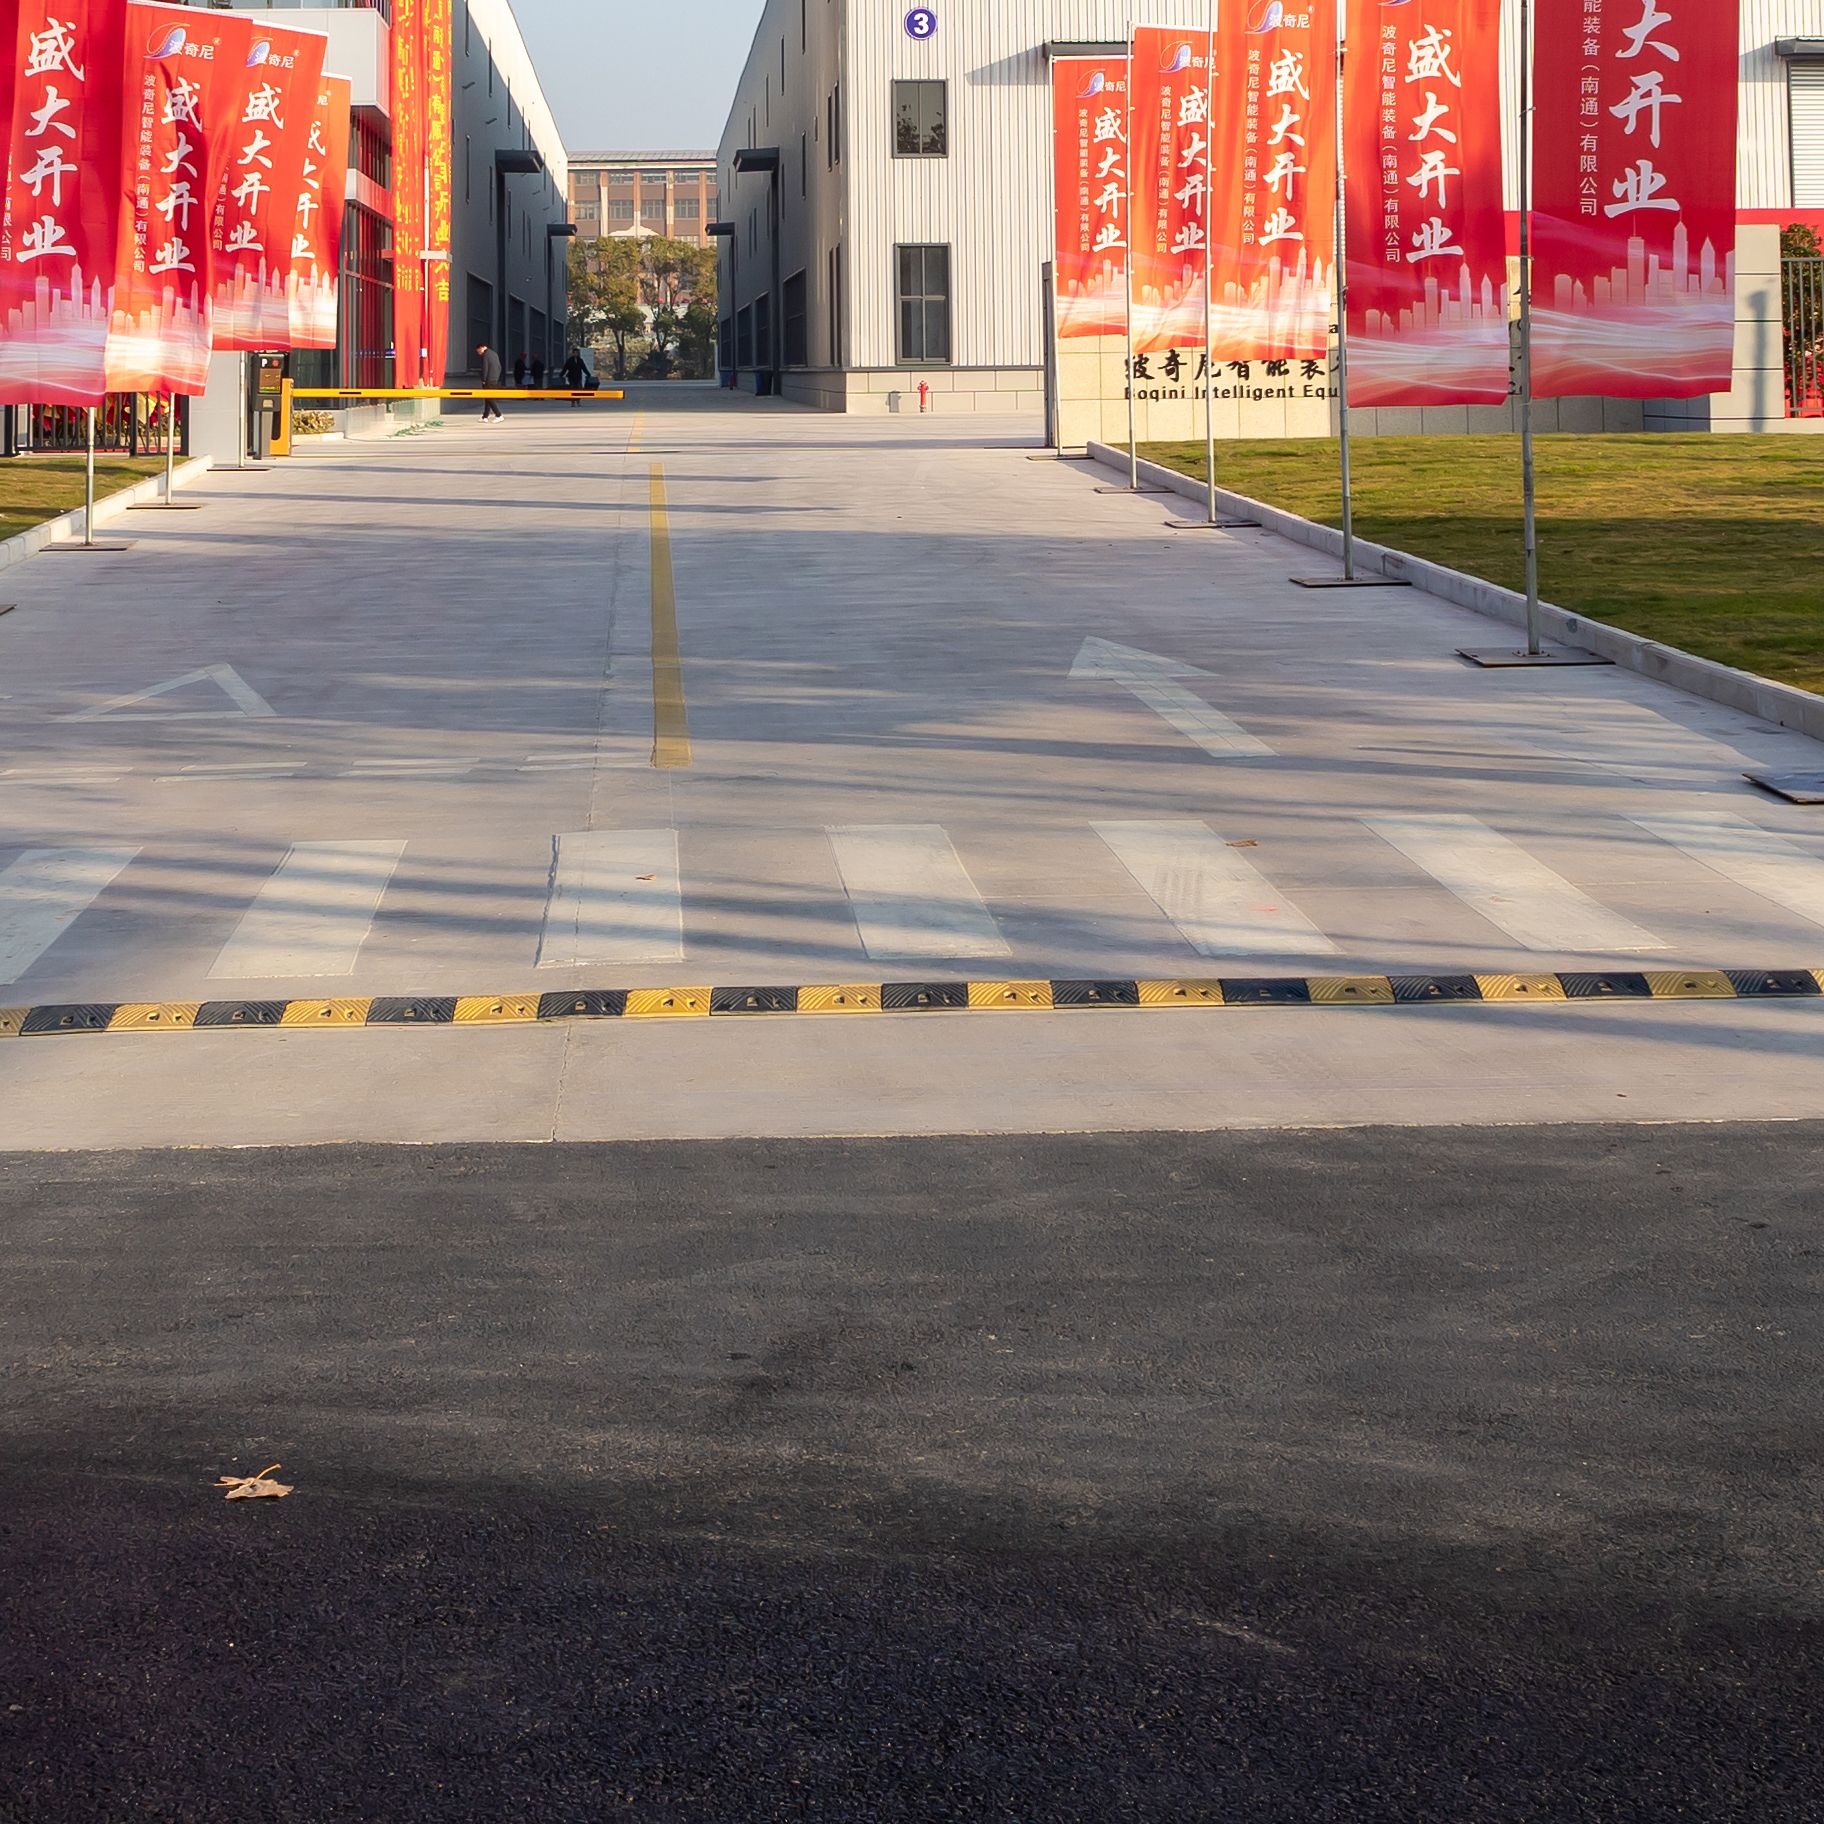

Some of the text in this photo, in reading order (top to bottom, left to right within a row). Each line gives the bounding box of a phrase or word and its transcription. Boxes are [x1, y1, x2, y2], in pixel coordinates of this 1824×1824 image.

[167, 37, 214, 60] 波奇尼
[914, 13, 929, 34] 3
[1269, 13, 1310, 29] 波奇尼
[16, 18, 85, 263] 盛大开业
[149, 78, 203, 274] 盛大开业
[225, 83, 284, 253] 盛大开业
[1092, 107, 1126, 252] 盛大开业
[1170, 85, 1215, 254] 盛大开业
[1258, 49, 1310, 246] 盛大开业
[1381, 26, 1401, 263] 波奇尼智能装备（南通）有限公司
[1405, 24, 1463, 263] 盛大开业
